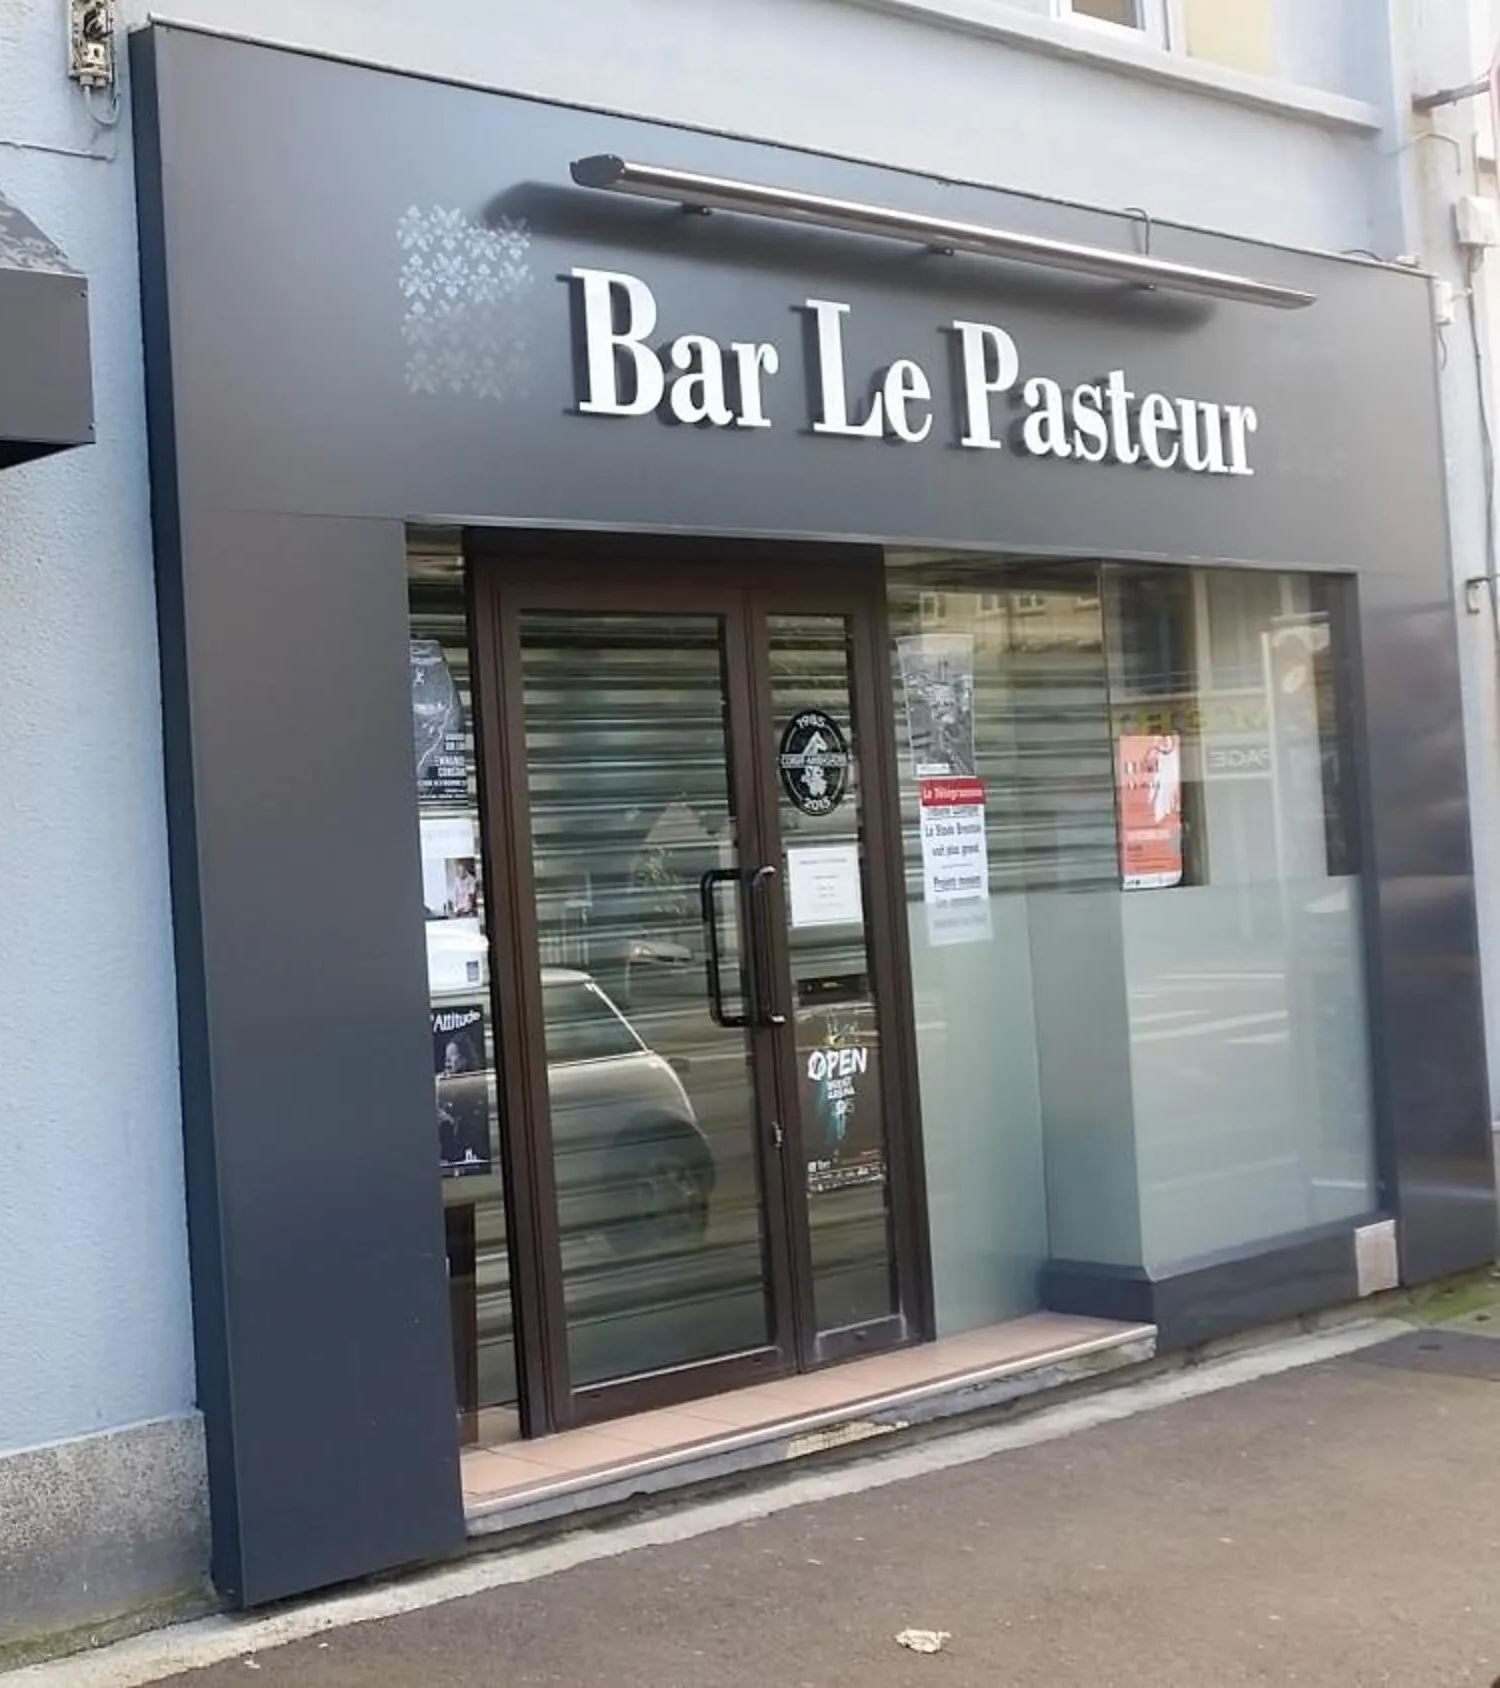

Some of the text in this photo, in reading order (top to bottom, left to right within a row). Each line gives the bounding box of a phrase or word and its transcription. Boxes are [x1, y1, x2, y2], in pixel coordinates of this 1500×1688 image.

[570, 267, 1259, 475] Bar Le Pasteur
[807, 1047, 867, 1081] OPEN
